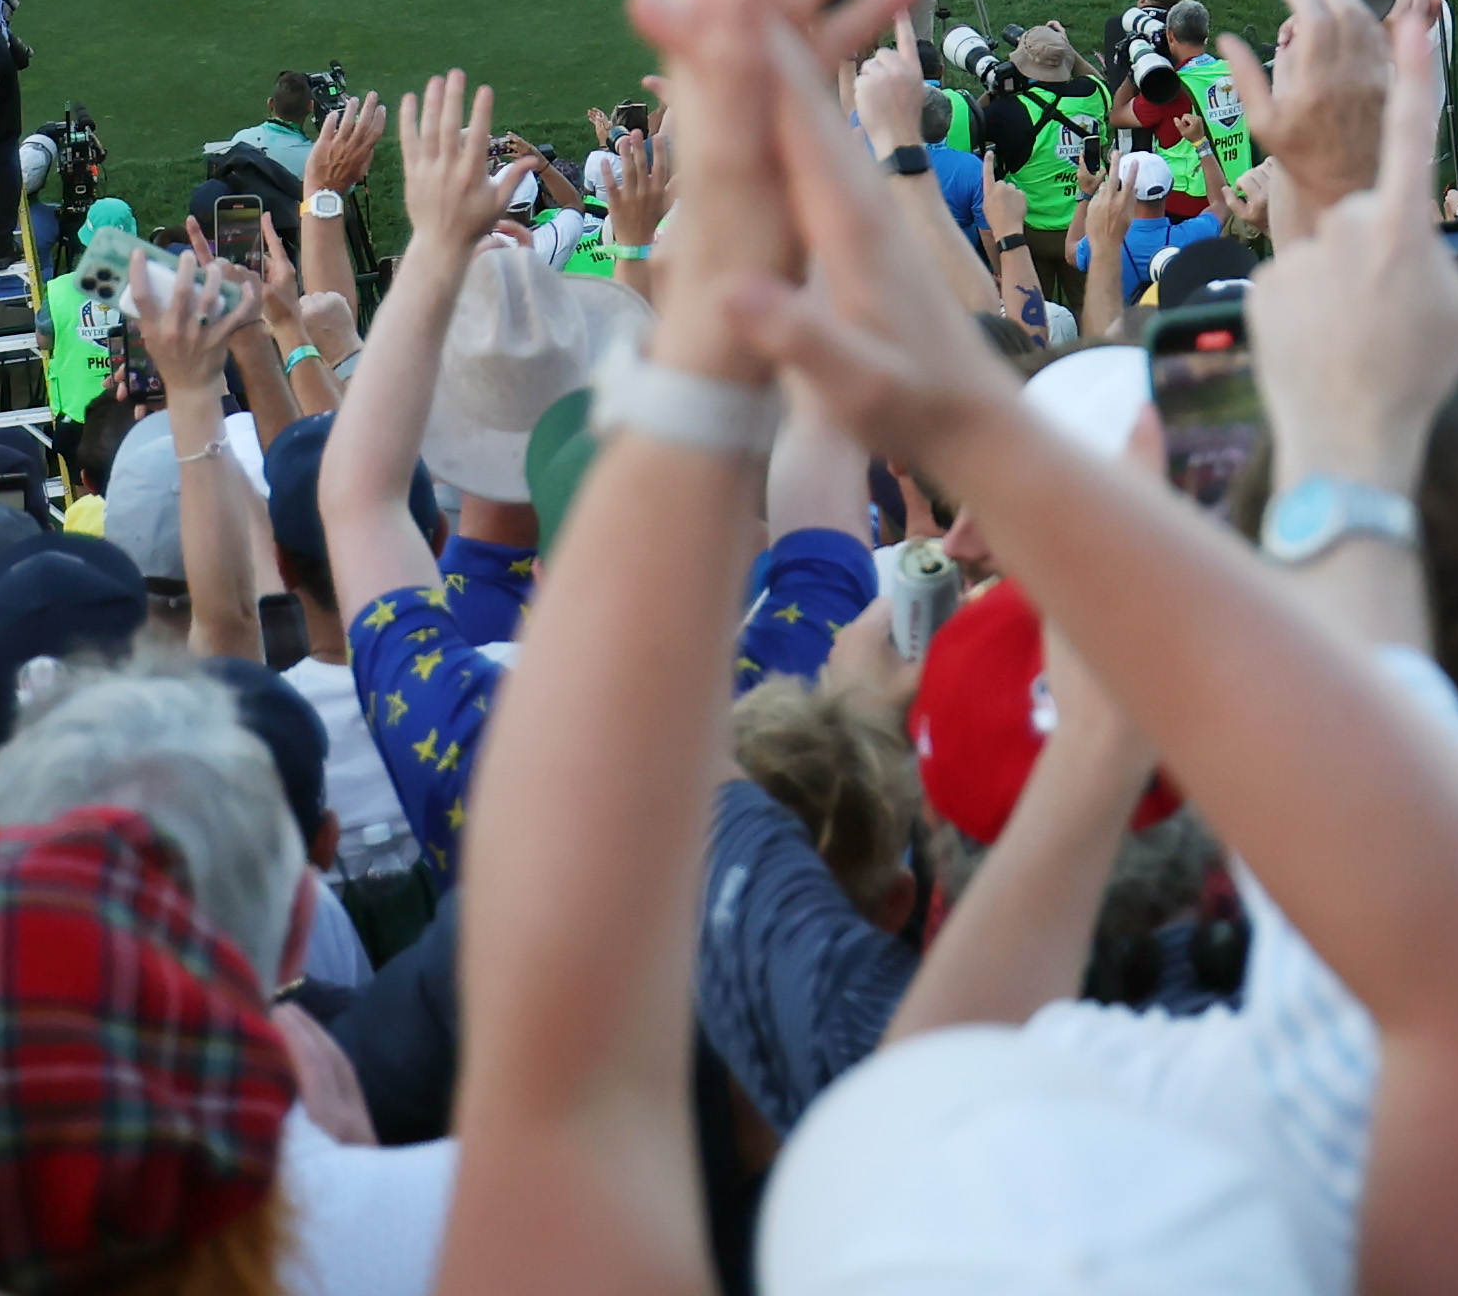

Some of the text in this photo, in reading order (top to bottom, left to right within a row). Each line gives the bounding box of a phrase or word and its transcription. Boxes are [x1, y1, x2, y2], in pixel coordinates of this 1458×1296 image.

[1208, 107, 1231, 119] RYDER
[1214, 132, 1244, 149] PHOTO
[1058, 146, 1084, 156] RYDE
[1223, 148, 1238, 162] 119
[1055, 172, 1078, 184] PHO
[81, 328, 108, 338] RYDE
